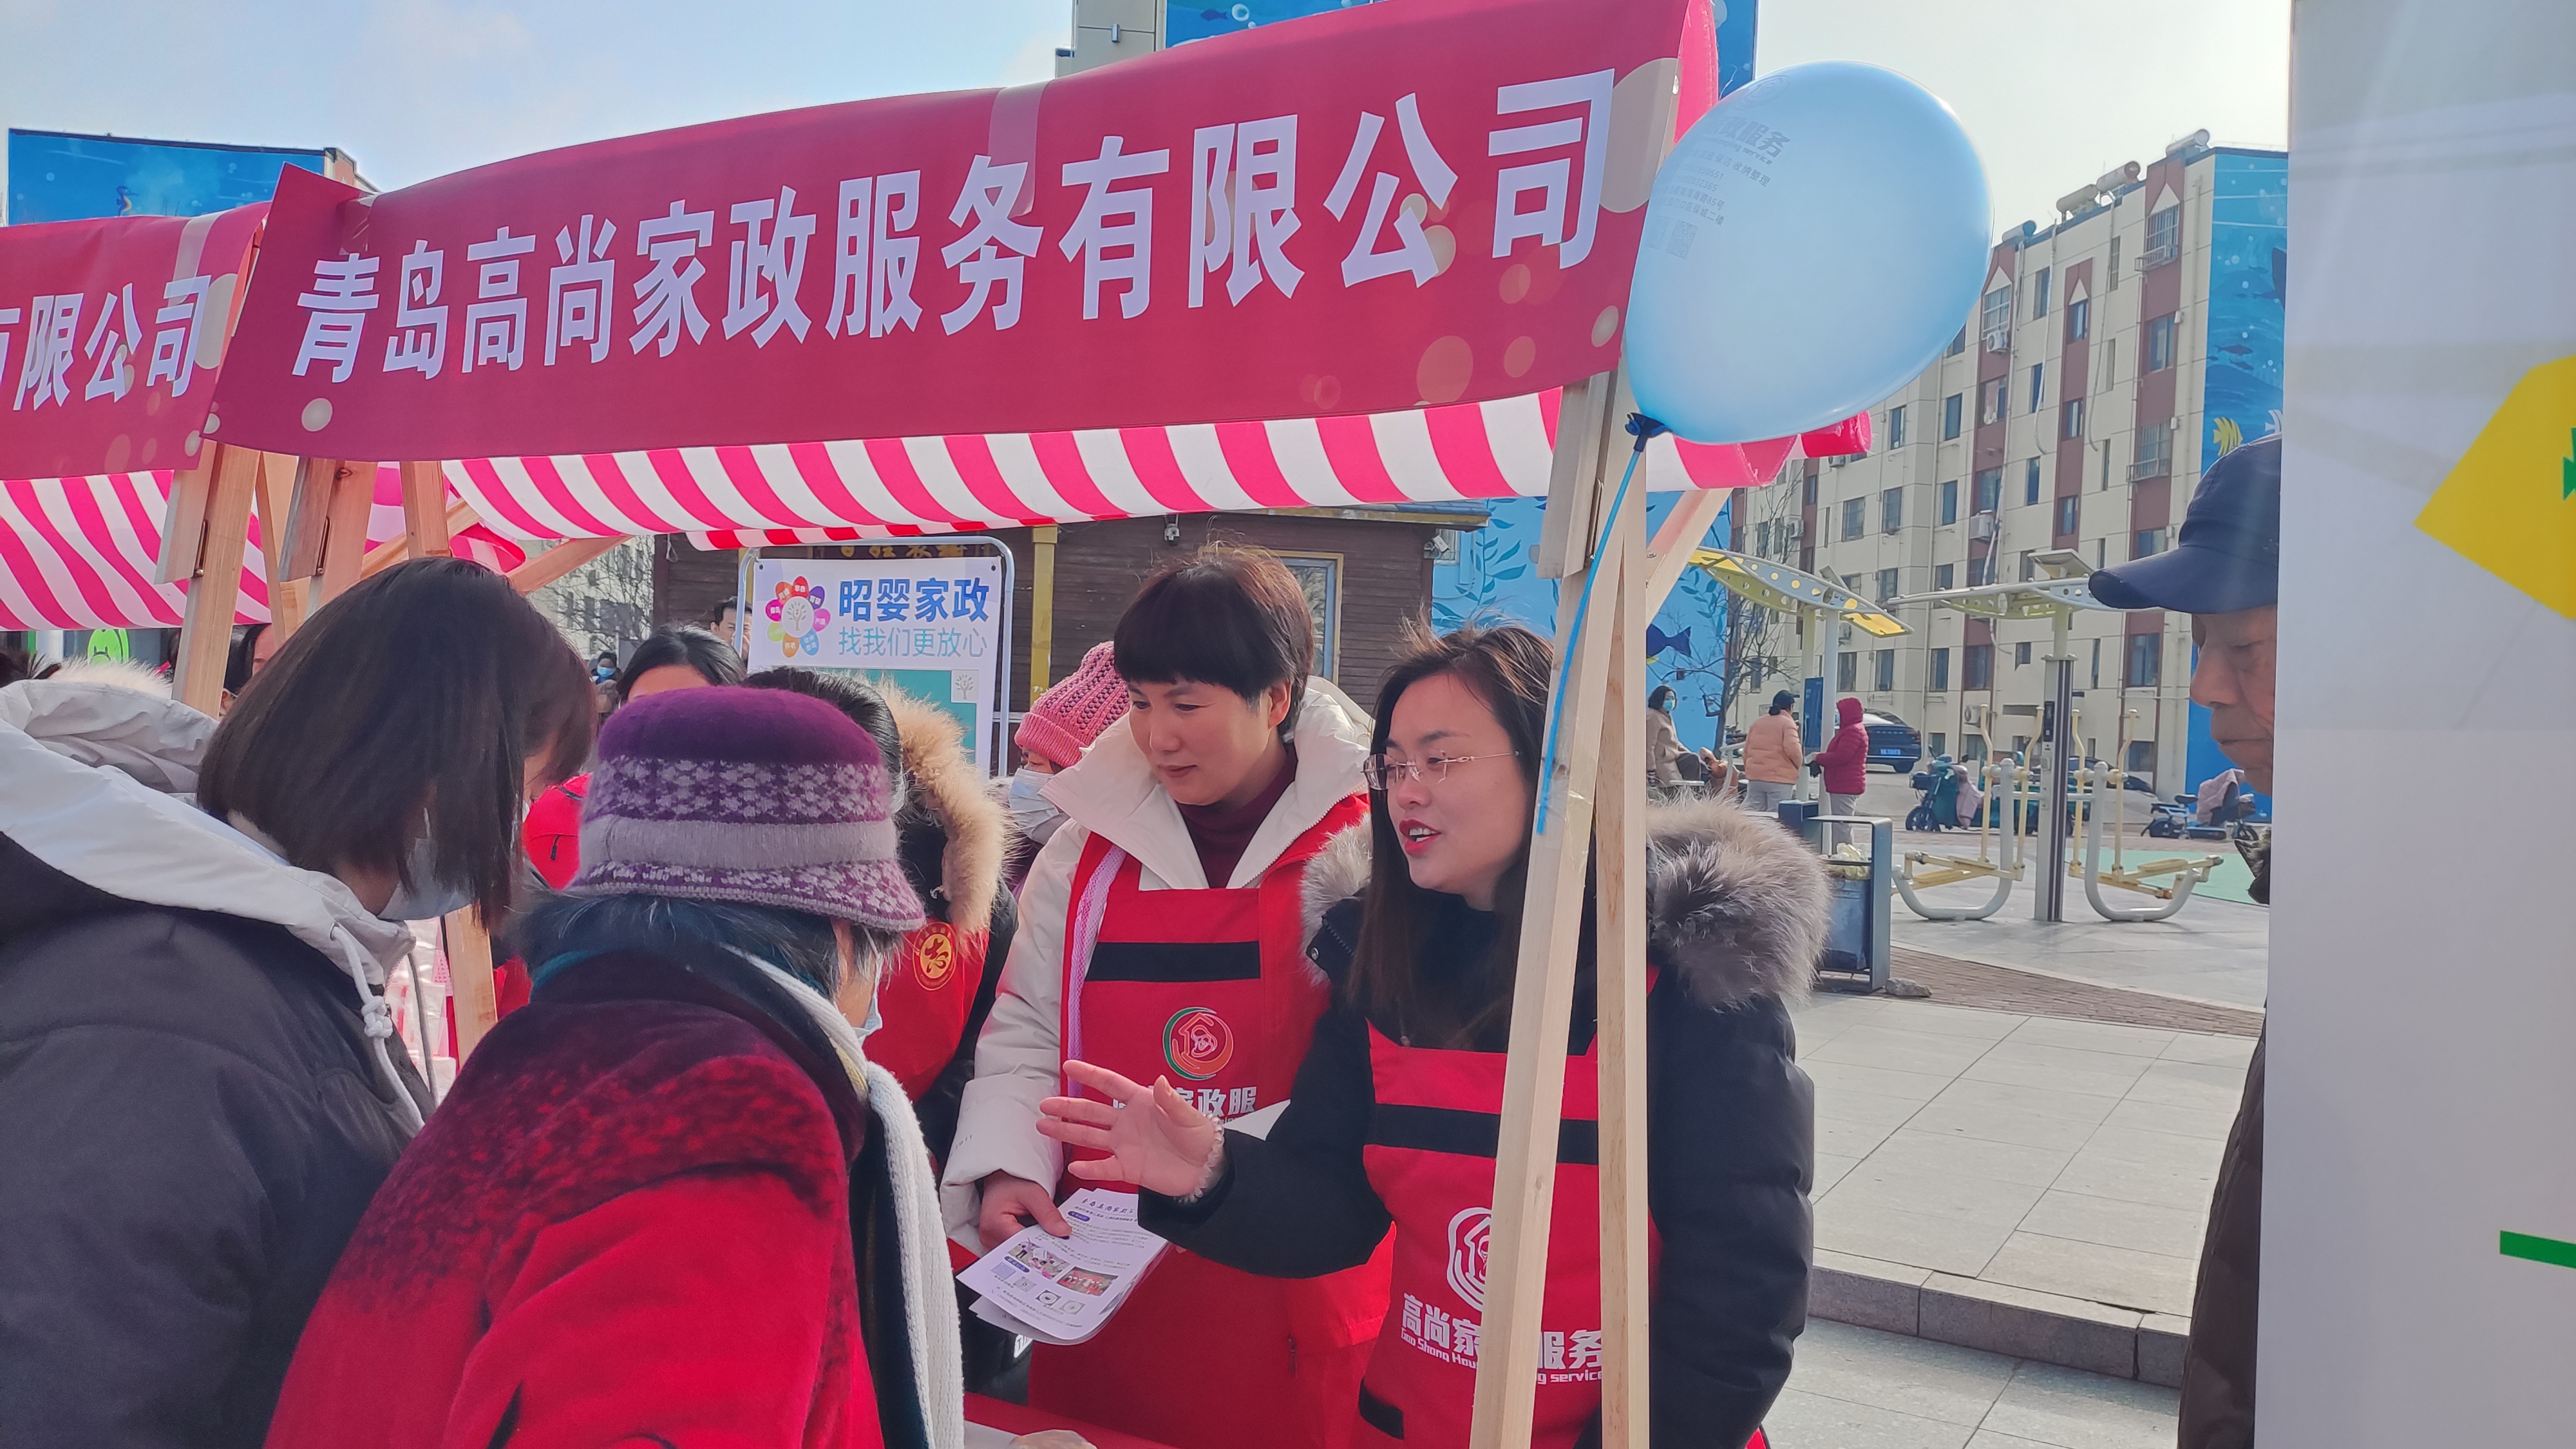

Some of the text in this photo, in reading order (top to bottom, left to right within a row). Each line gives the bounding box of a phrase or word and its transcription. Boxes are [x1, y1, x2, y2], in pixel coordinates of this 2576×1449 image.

[1733, 162, 1770, 187] 收纳整理
[292, 68, 1615, 383] 青岛高尚家政服务有限公司
[839, 577, 989, 622] 昭婴家政
[838, 626, 987, 658] 找我们更放心
